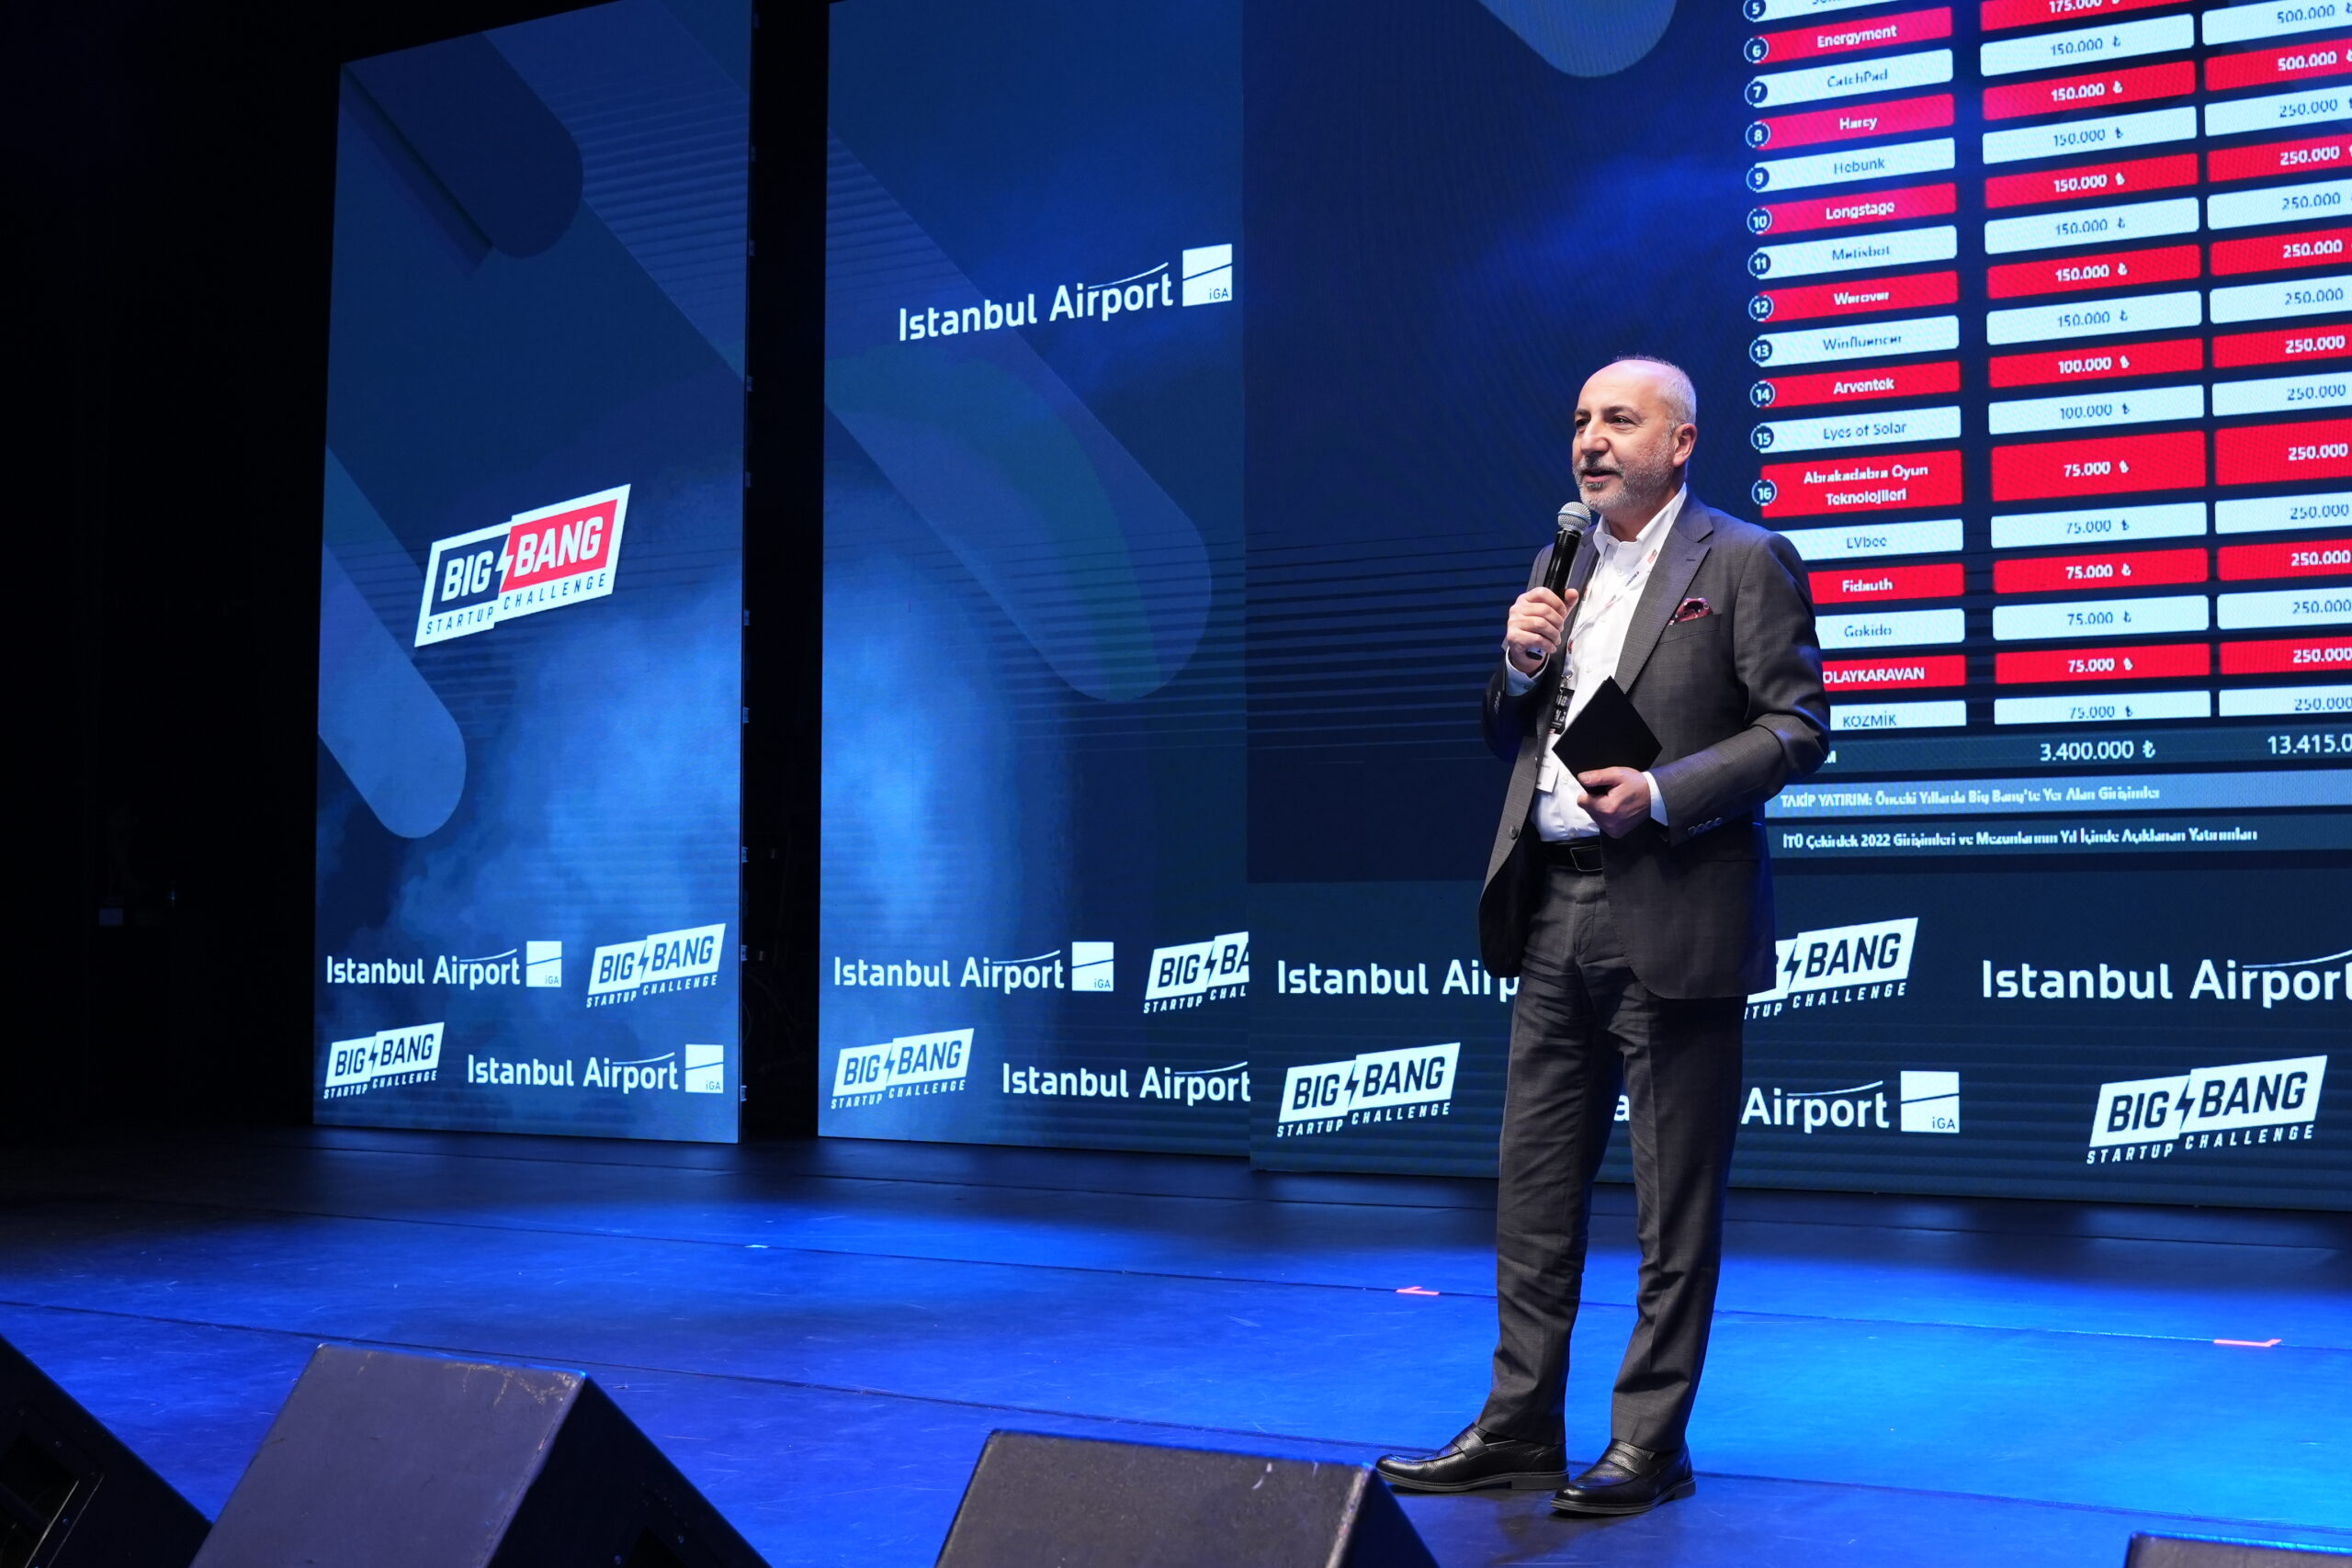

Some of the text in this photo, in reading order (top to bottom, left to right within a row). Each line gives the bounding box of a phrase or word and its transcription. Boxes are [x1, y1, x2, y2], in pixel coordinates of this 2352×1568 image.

[1753, 3, 1759, 14] 5
[2278, 5, 2335, 24] 500.000
[1753, 46, 1761, 57] 6
[2051, 39, 2103, 56] 150.000
[2278, 51, 2336, 71] 500.000
[1753, 86, 1761, 97] 7
[2052, 84, 2105, 101] 150.000
[2279, 99, 2337, 118] 250.000
[1754, 130, 1762, 141] 8
[2053, 130, 2106, 146] 150.000
[2280, 146, 2340, 165] 250.000
[1755, 174, 1763, 185] 9
[2054, 175, 2108, 192] 150.000
[2282, 193, 2340, 210] 250.000
[1826, 202, 1894, 220] Longstage
[1753, 217, 1767, 228] 10
[2056, 219, 2108, 235] 150.000
[2282, 240, 2342, 258] 250.000
[1755, 258, 1766, 269] 11
[2056, 265, 2109, 281] 150.000
[2285, 288, 2344, 305] 250.000
[899, 273, 1174, 341] Istanbul Airport
[1755, 302, 1768, 313] 12
[2058, 311, 2109, 327] 150.000
[1755, 345, 1769, 356] 13
[2286, 336, 2346, 354] 250.000
[2058, 356, 2111, 374] 100.000
[1756, 389, 1770, 400] 14
[2287, 384, 2346, 400] 250.000
[2060, 404, 2112, 420] 100.000
[1873, 423, 1906, 434] Solar
[1757, 432, 1770, 444] 15
[2288, 443, 2347, 460] 250.000
[1893, 465, 1928, 479] Oyun
[2064, 462, 2110, 477] 75.000
[1758, 487, 1771, 499] 16
[2290, 504, 2349, 520] 250.000
[2066, 520, 2111, 534] 75.000
[441, 516, 604, 602] BIG BANG
[2291, 549, 2351, 567] 250.000
[2065, 564, 2113, 580] 75.000
[426, 573, 605, 635] STARTUP CHALLENGE
[2293, 600, 2352, 615] 250.000
[2067, 612, 2113, 626] 75.000
[2293, 648, 2352, 662] 250.000
[2069, 658, 2114, 672] 75.000
[1823, 667, 1925, 683] OLAYKARAVAN
[2070, 705, 2115, 719] 75.000
[2295, 696, 2352, 711] 250.000
[2041, 740, 2133, 761] 3.400.000
[1860, 833, 1890, 847] 2022
[599, 936, 715, 984] BIG BANG
[1804, 933, 1901, 978] BANG
[327, 954, 520, 990] Istanbul Airport
[834, 957, 1064, 994] Istanbul Airport
[1158, 954, 1198, 987] BIG
[1983, 960, 2172, 998] Istanbul
[1278, 959, 1520, 1002] Istanbul Airp
[586, 975, 718, 1007] STARTUP CHALLENGE
[1792, 982, 1906, 1009] CHALLENGE
[1144, 996, 1203, 1013] STARTUP
[335, 1033, 435, 1077] BIG BANG
[843, 1040, 962, 1086] BIG BANG
[468, 1055, 678, 1094] Istanbul Airport
[324, 1070, 436, 1099] STARTUP CHALLENGE
[1003, 1063, 1250, 1106] Istanbul Airport
[1292, 1056, 1445, 1111] BIG BANG
[831, 1079, 966, 1109] STARTUP CHALLENGE
[2107, 1071, 2308, 1133] BIG BANG
[1741, 1087, 1889, 1133] Airport
[1277, 1102, 1451, 1138] STARTUP CHALLENGE
[2086, 1124, 2314, 1164] STARTUP CHALLENGE
